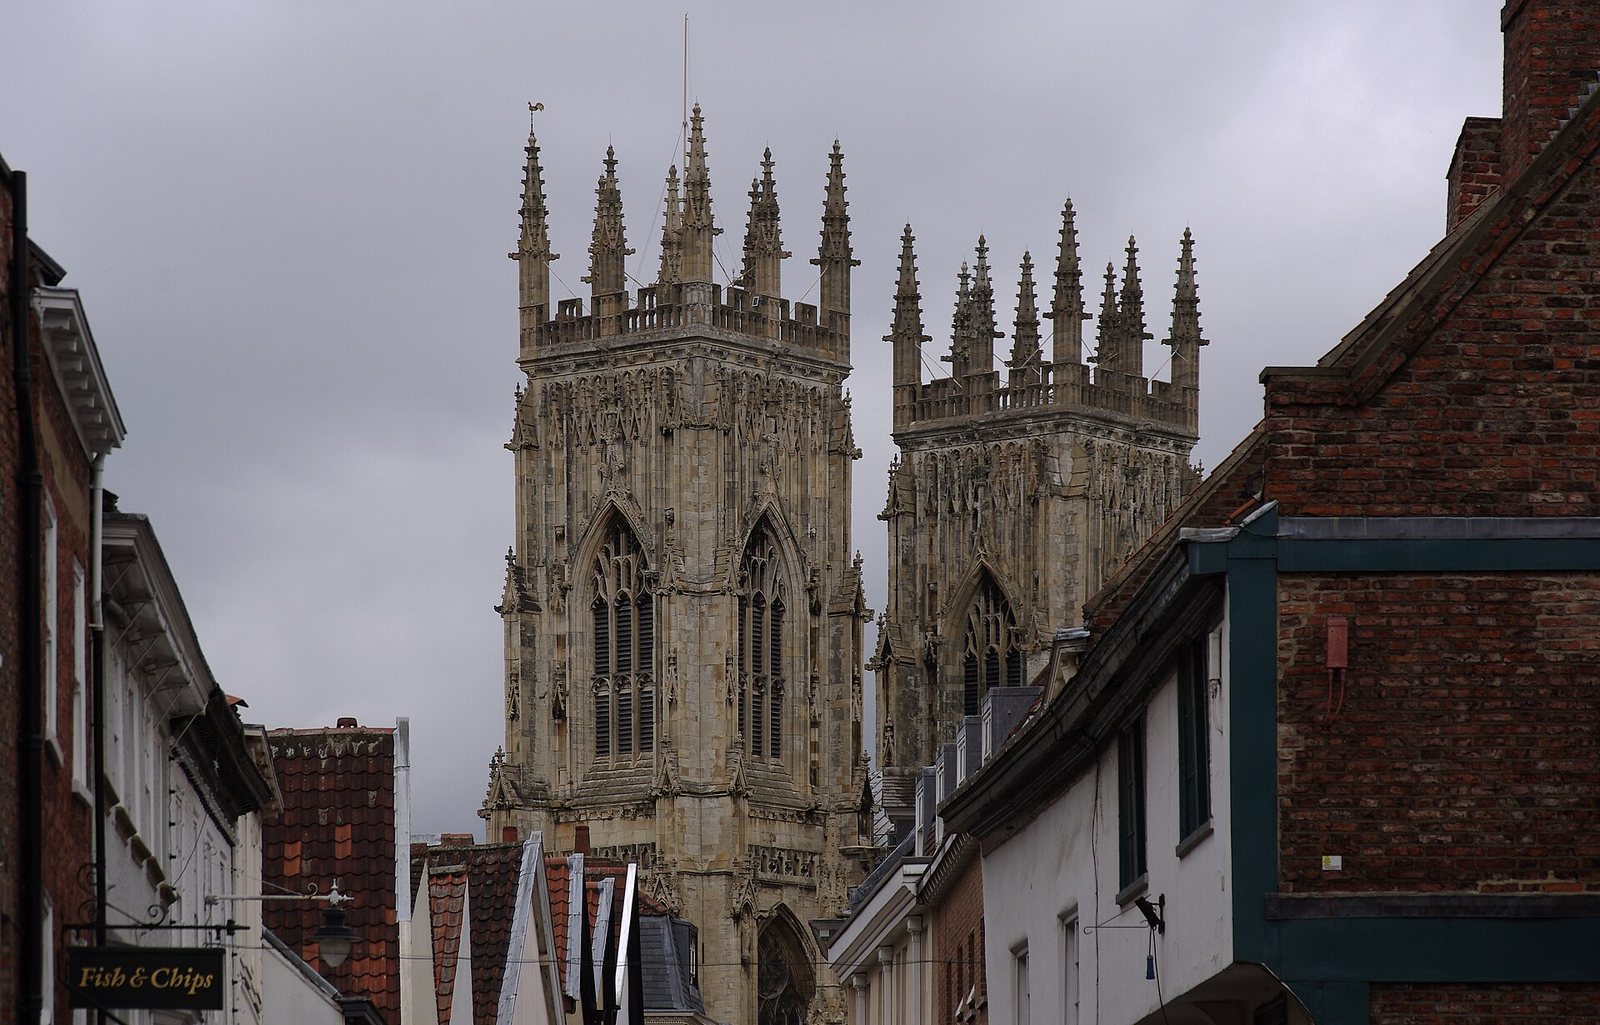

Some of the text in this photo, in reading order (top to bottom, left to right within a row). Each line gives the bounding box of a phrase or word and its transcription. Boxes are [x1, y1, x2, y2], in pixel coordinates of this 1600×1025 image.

[79, 967, 214, 995] Fish & Chips
